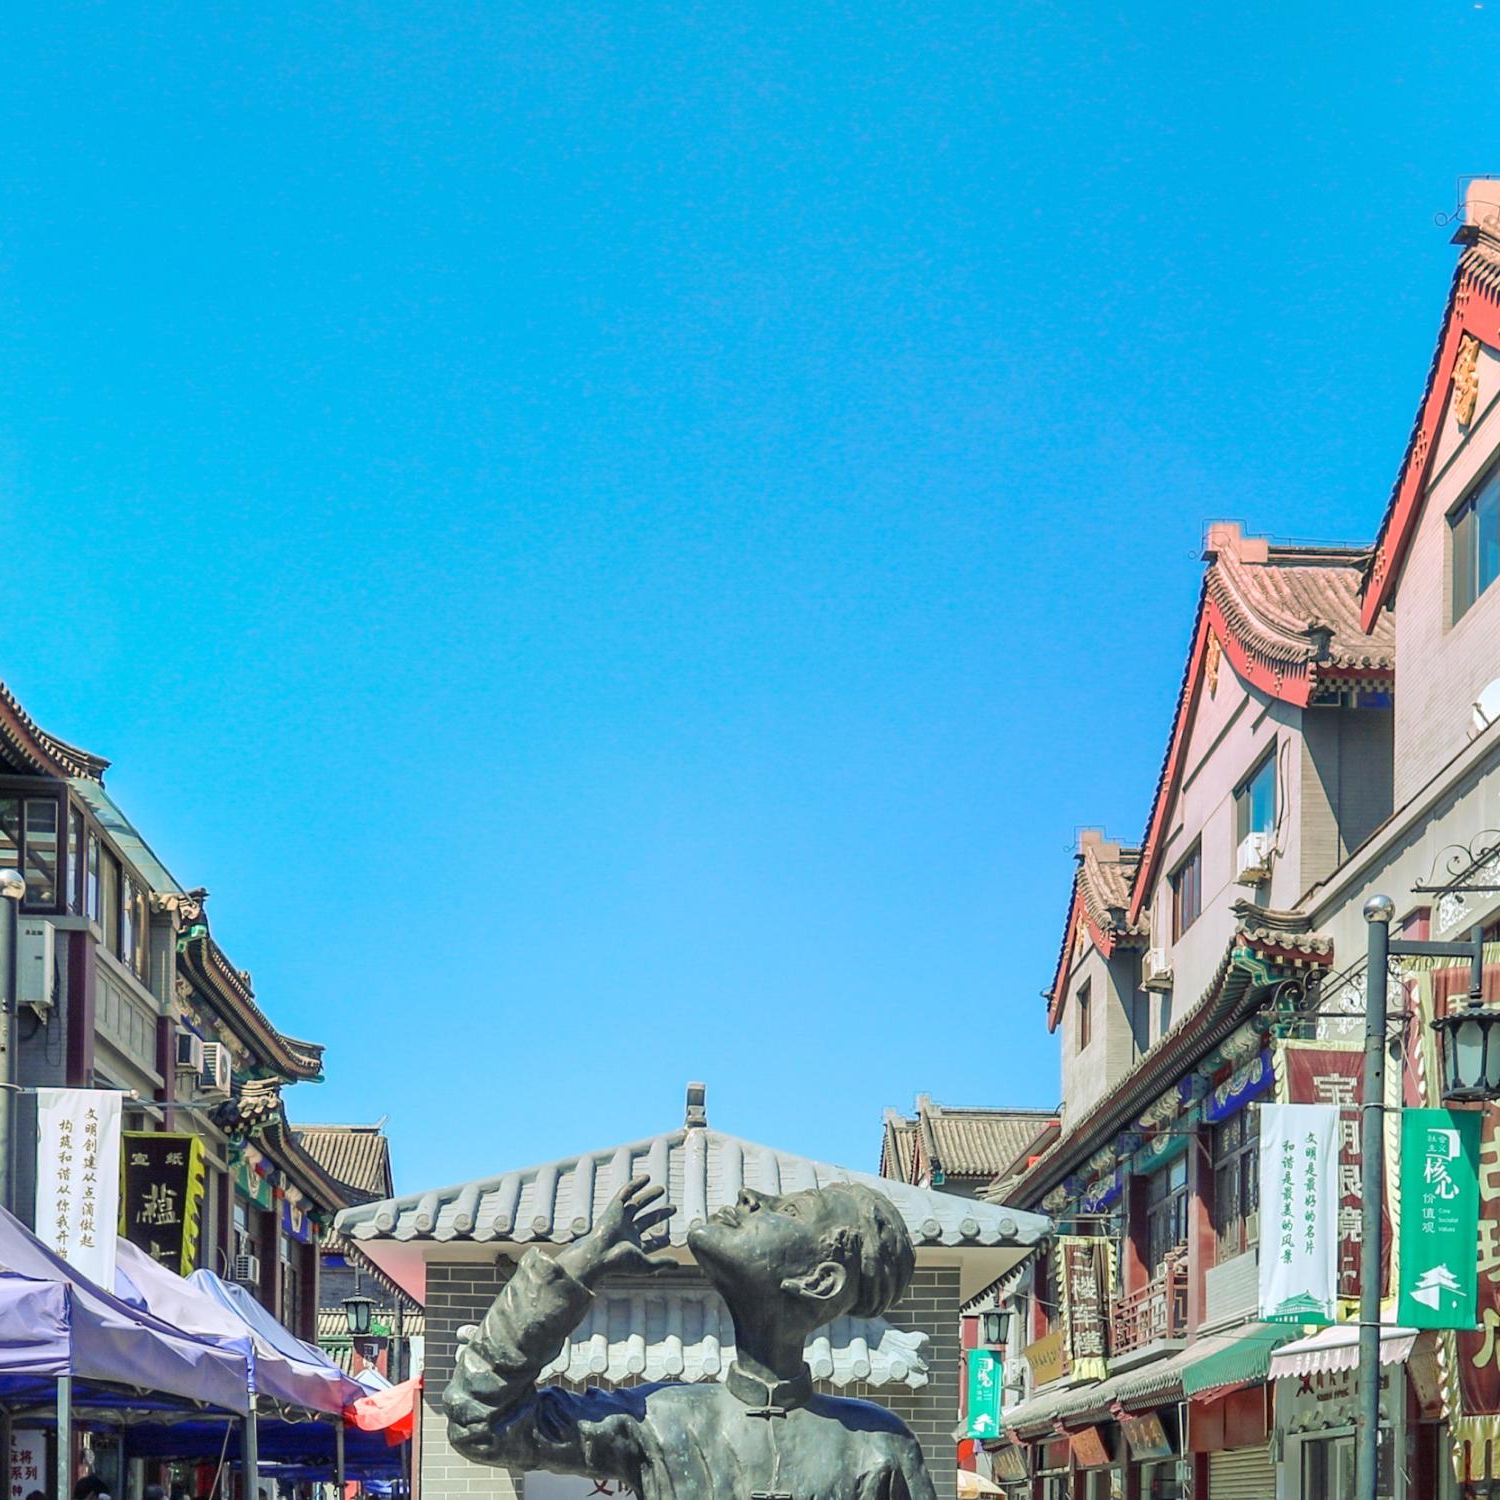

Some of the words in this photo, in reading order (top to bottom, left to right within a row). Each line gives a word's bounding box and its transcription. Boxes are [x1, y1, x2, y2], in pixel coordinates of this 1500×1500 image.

[80, 1107, 98, 1248] 文明创建从点滴做起
[130, 1152, 184, 1167] 宣纸
[1303, 1131, 1318, 1255] 文明是最好的名片
[1423, 1157, 1460, 1199] 核心
[1280, 1139, 1296, 1264] 和谐是最美的风景
[1422, 1193, 1436, 1233] 价值观
